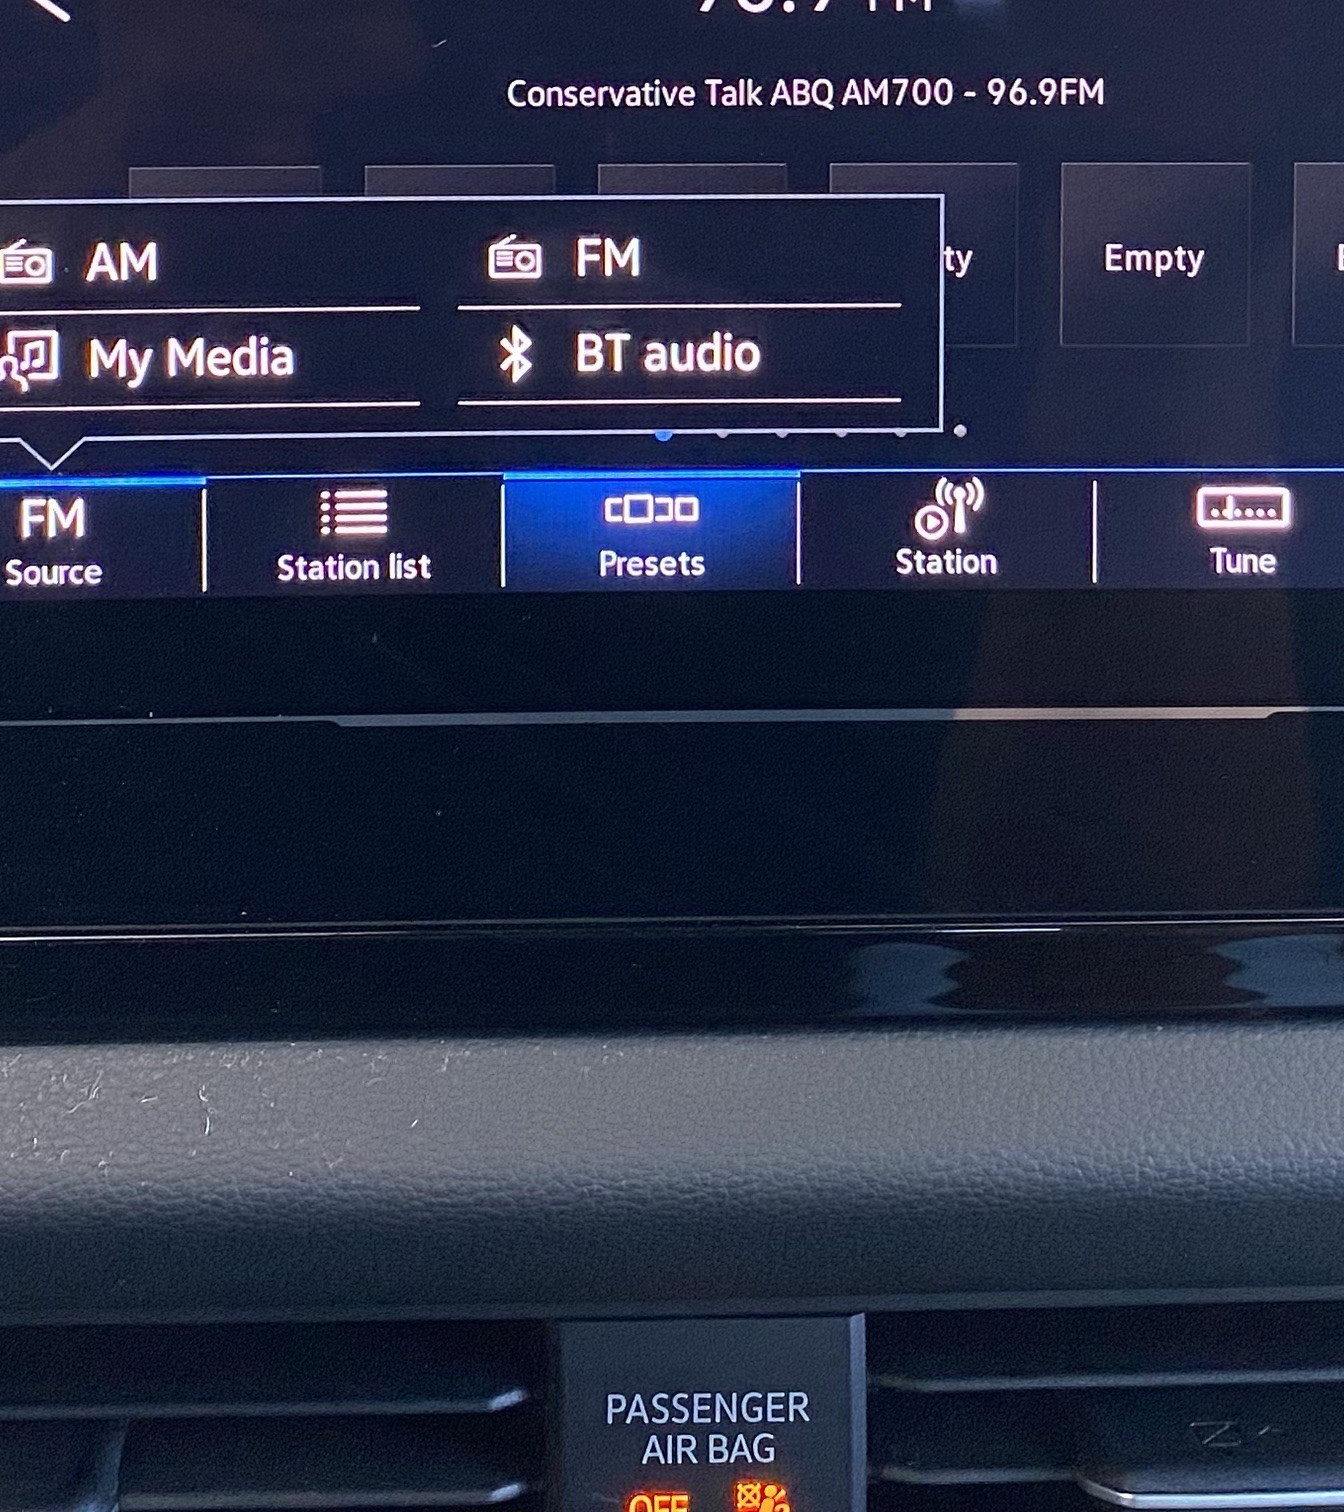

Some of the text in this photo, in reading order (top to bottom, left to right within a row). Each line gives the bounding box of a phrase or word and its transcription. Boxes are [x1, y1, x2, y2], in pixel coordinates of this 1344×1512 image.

[507, 78, 696, 107] Conservative
[704, 78, 763, 107] Talk
[769, 78, 835, 111] ABQ
[841, 77, 954, 106] AM700
[987, 77, 1104, 106] 96.9FM
[85, 241, 158, 283] AM
[577, 237, 641, 277] FM
[1105, 243, 1205, 278] Empty
[89, 334, 295, 389] My Media
[577, 330, 761, 373] BT audio
[20, 495, 86, 539] FM
[5, 558, 103, 587] Source
[277, 552, 432, 582] Station list
[599, 550, 706, 577] Presets
[896, 547, 998, 575] Station
[1209, 546, 1278, 574] Tune
[607, 1391, 810, 1425] PASSENGER
[641, 1432, 775, 1465] AIR BAG
